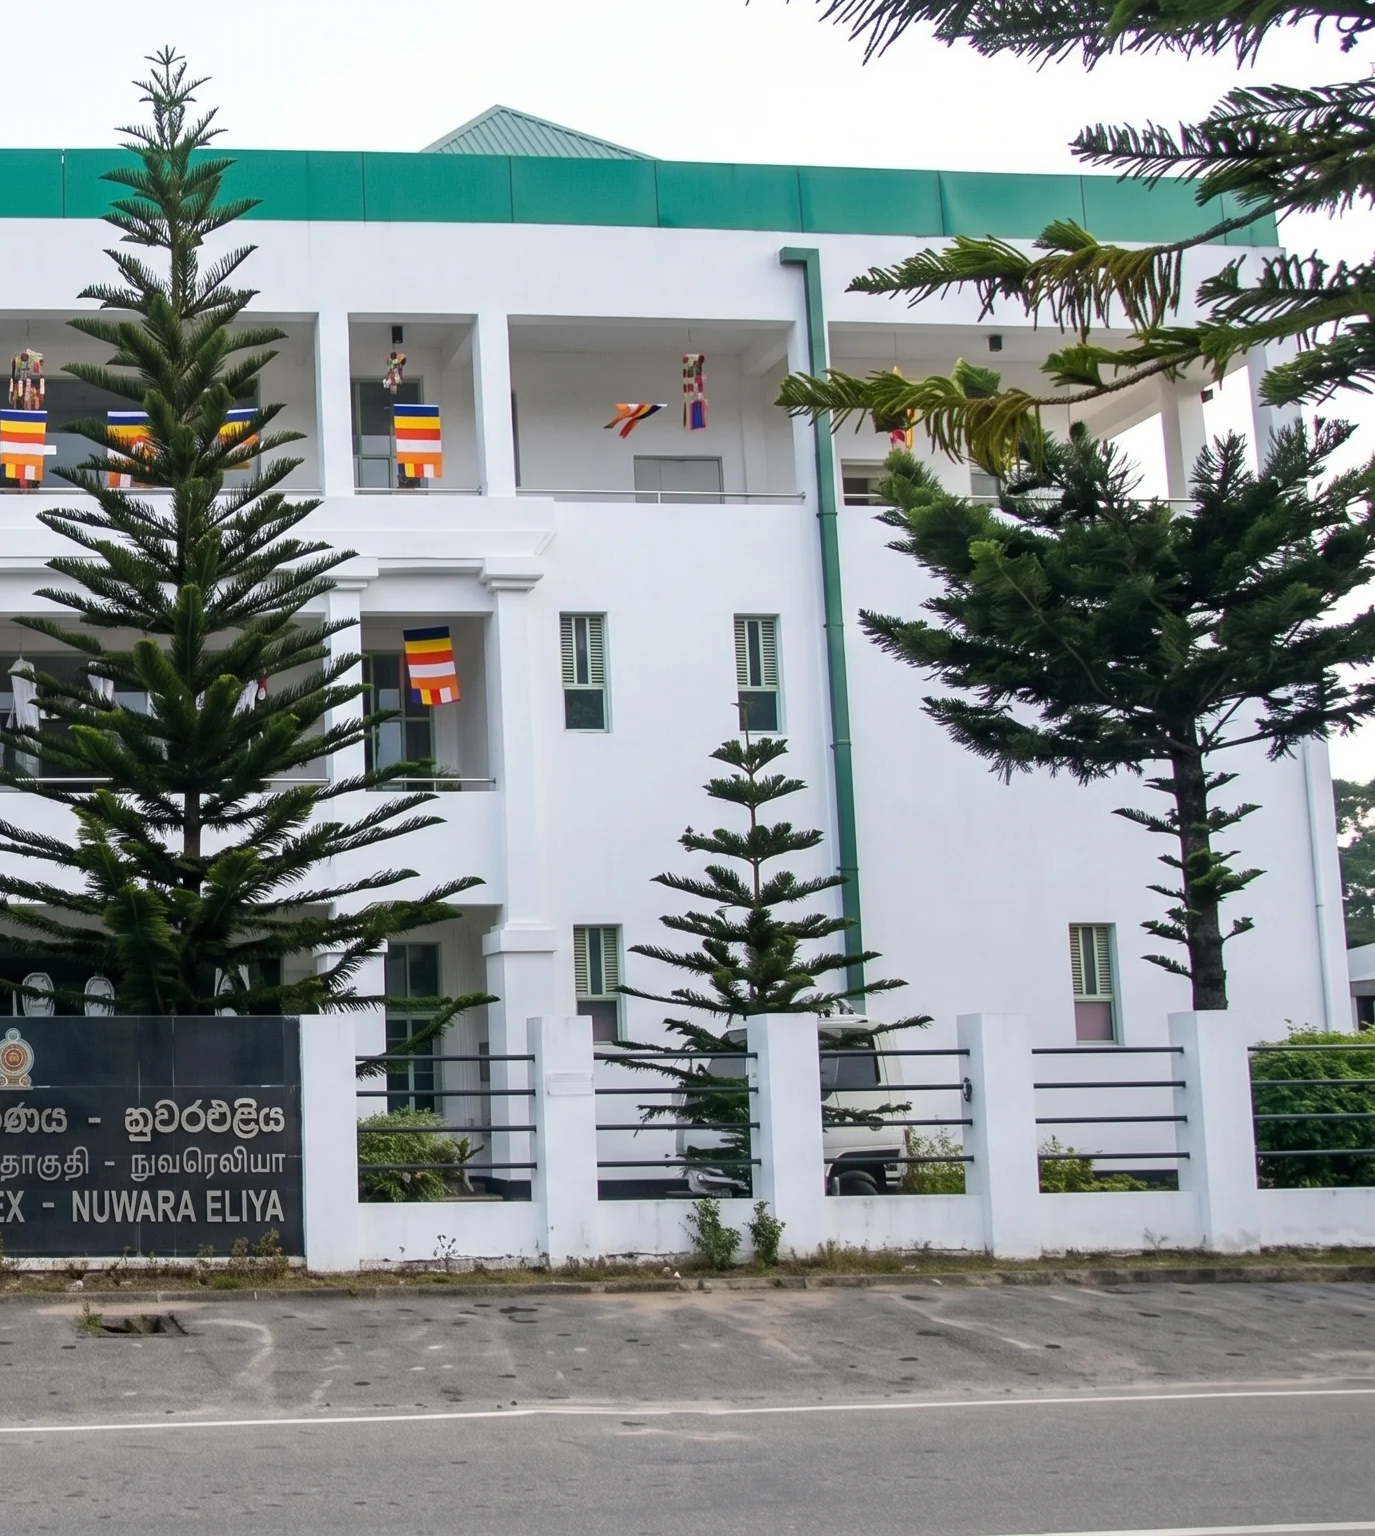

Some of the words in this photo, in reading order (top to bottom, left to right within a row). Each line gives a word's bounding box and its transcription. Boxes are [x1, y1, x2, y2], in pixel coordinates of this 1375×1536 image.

[130, 1145, 286, 1182] நுவரெலியா
[72, 1189, 197, 1223] NUWARA
[206, 1189, 285, 1223] ELIYA
